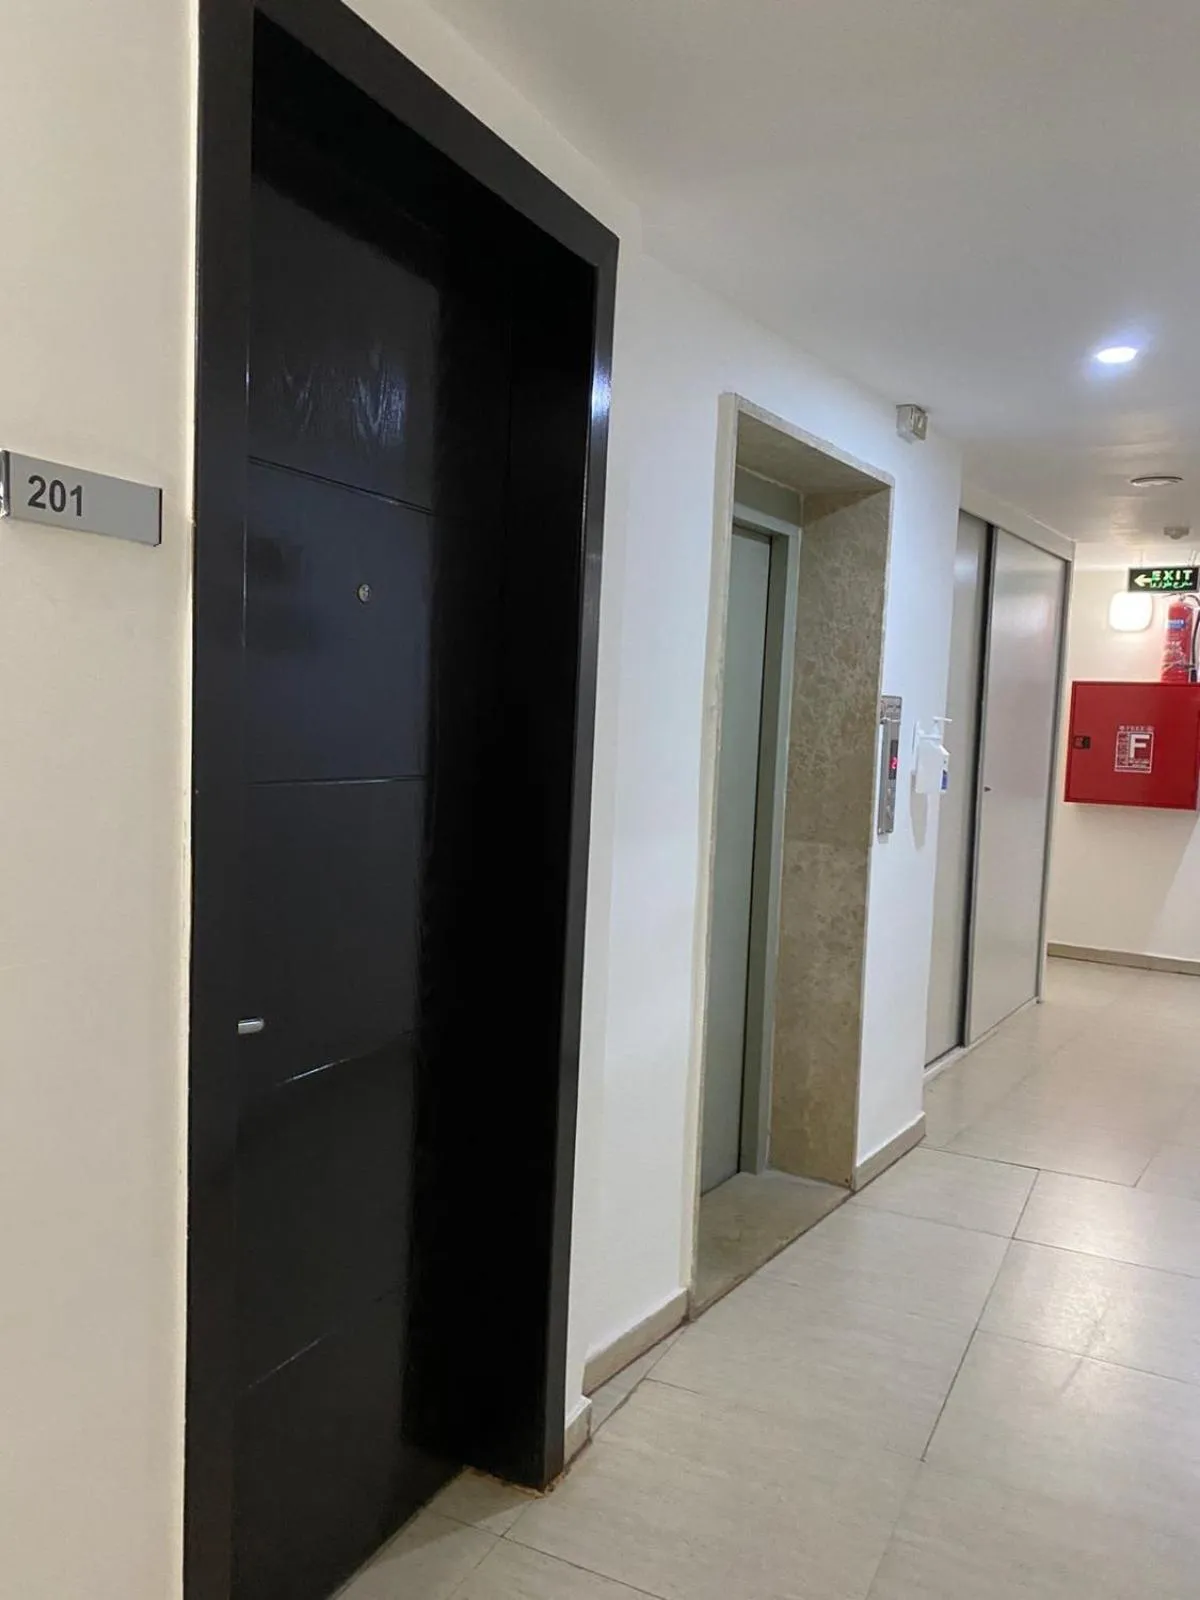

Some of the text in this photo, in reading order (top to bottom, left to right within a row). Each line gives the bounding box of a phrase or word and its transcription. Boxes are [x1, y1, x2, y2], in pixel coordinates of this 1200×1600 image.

[28, 475, 83, 516] 201
[1152, 570, 1193, 580] EXIT
[1129, 734, 1150, 758] F
